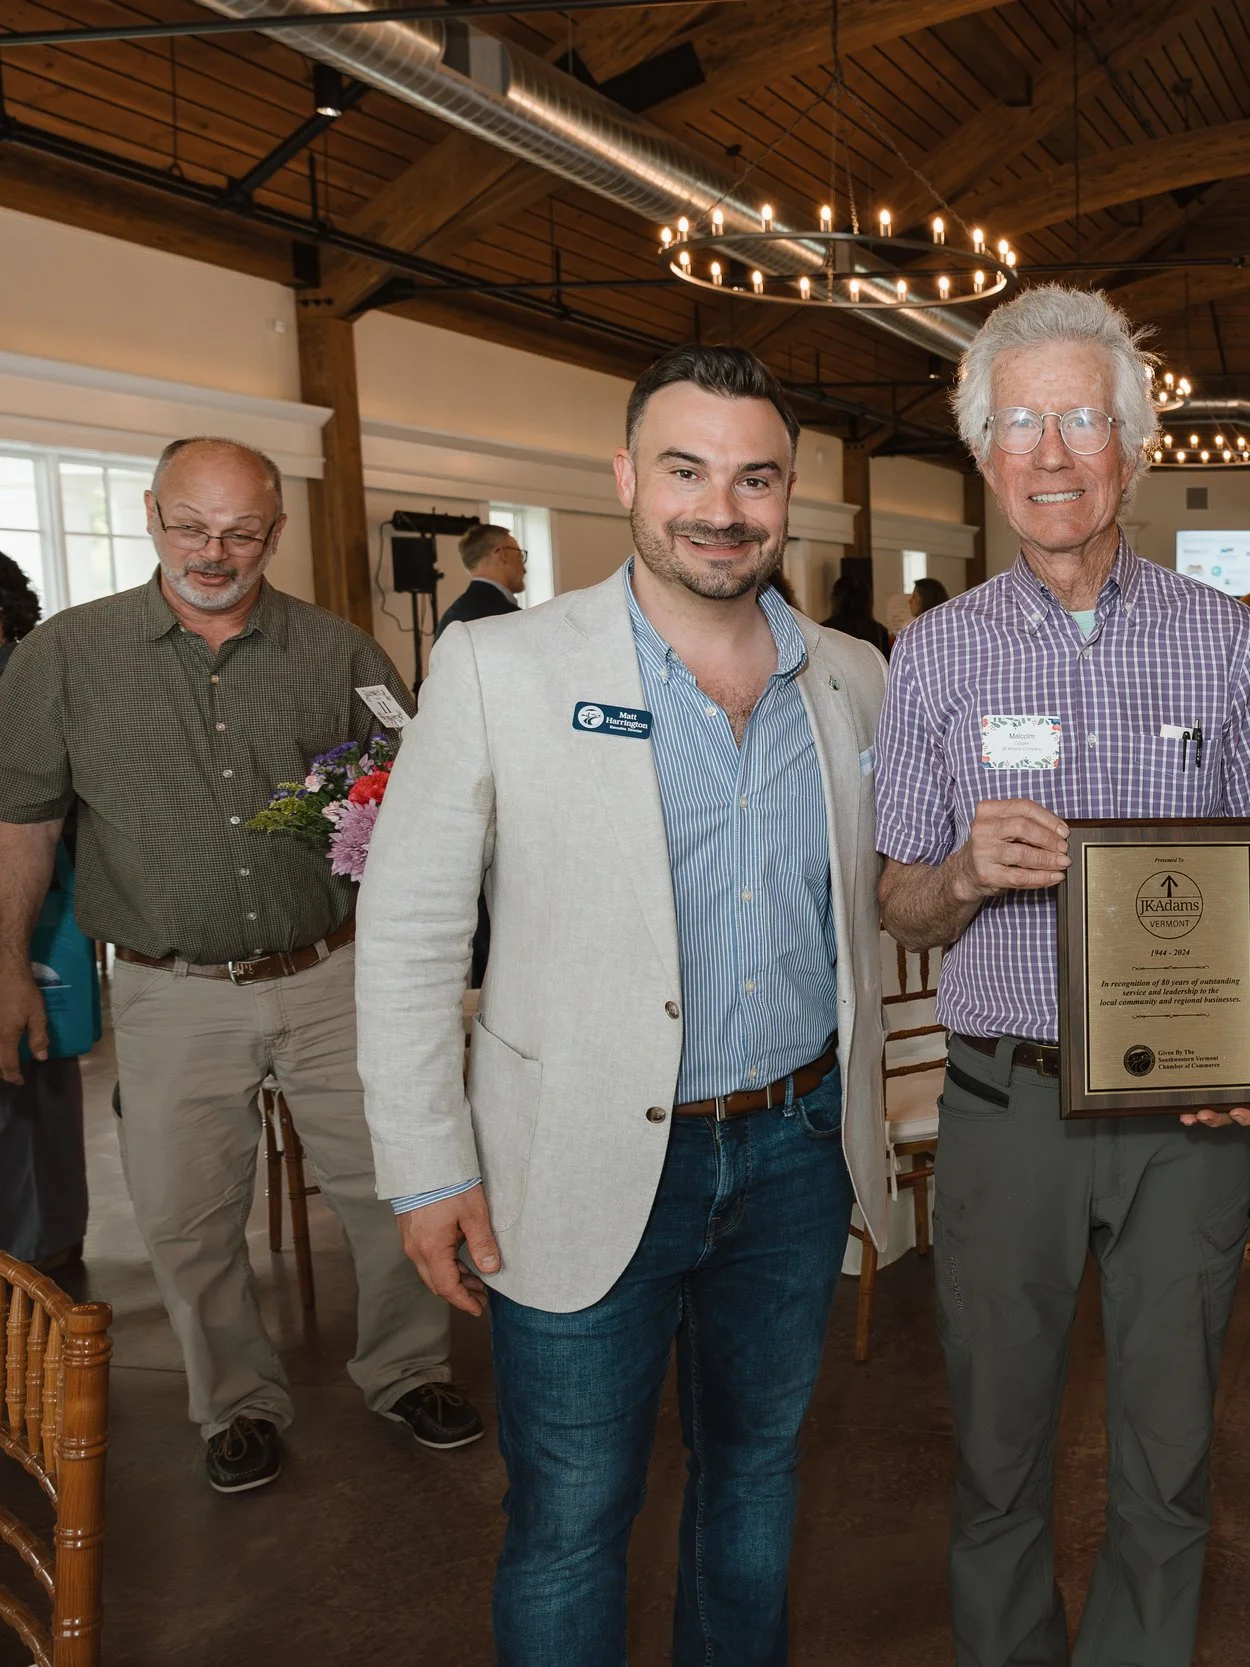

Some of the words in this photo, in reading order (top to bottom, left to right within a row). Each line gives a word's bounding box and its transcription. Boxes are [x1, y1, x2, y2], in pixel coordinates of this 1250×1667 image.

[619, 712, 637, 720] Matt
[606, 717, 648, 728] Harrington
[1150, 920, 1189, 928] VERMONT
[1111, 980, 1150, 989] recognition
[1152, 979, 1160, 988] of
[1170, 980, 1190, 988] years
[1191, 979, 1200, 987] of
[1200, 978, 1240, 987] outstanding
[1163, 988, 1199, 997] leadership
[1118, 998, 1157, 1007] community
[1174, 997, 1202, 1006] regional
